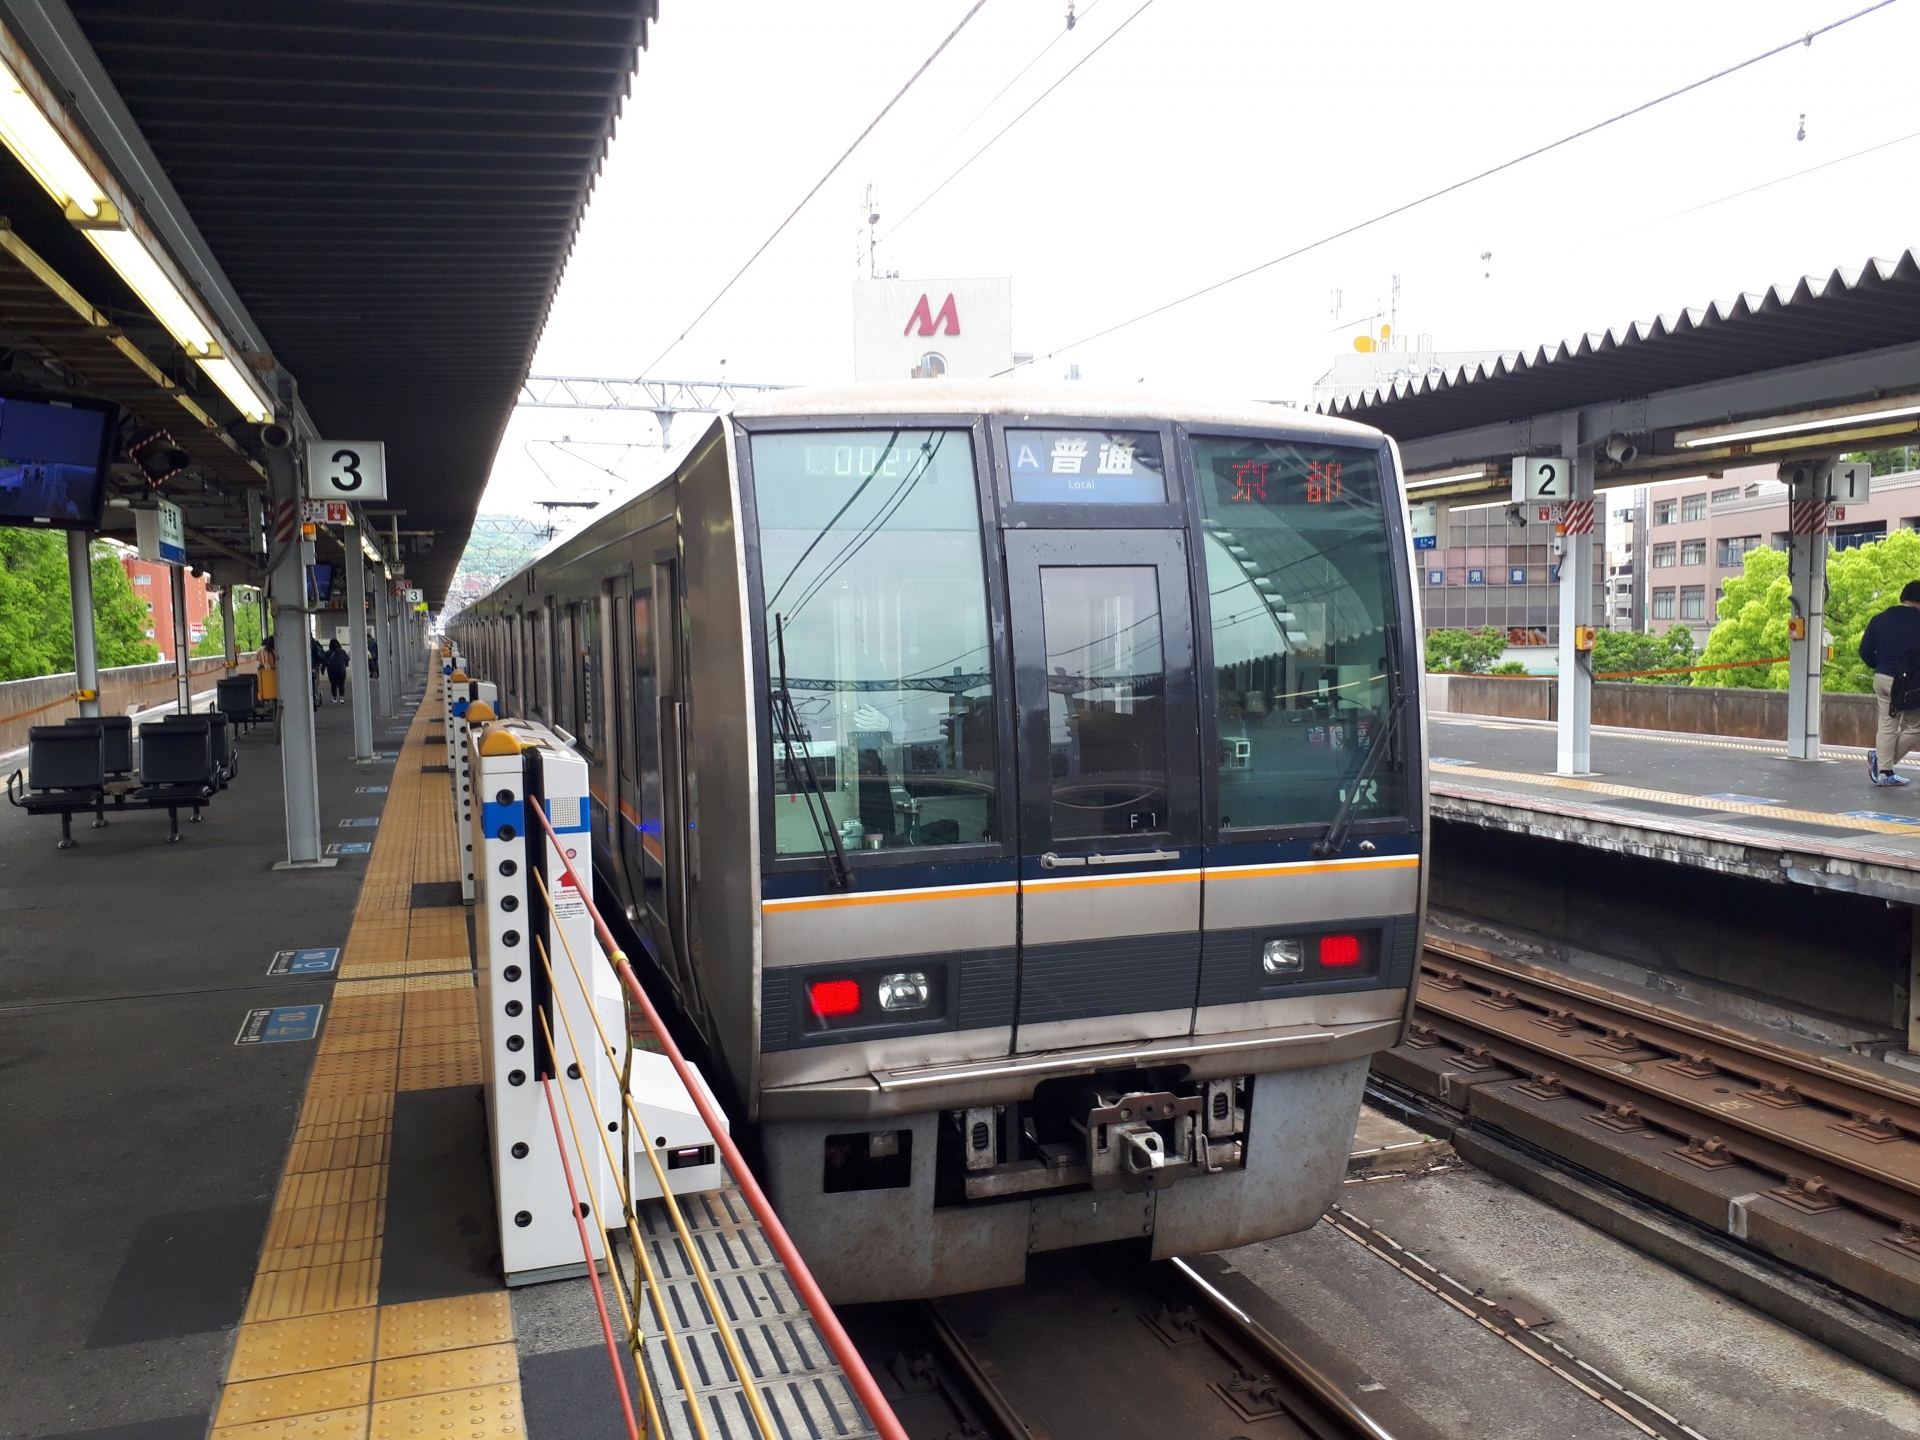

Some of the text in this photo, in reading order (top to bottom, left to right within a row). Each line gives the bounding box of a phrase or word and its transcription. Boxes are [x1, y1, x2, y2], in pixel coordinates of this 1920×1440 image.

[331, 449, 362, 492] 3
[1017, 437, 1138, 475] A 普通
[1068, 480, 1095, 490] Local
[1232, 459, 1342, 503] 京都
[1538, 464, 1556, 496] 2
[1845, 469, 1855, 498] 1
[243, 592, 252, 602] 4
[410, 591, 418, 601] 3
[1130, 813, 1138, 829] F
